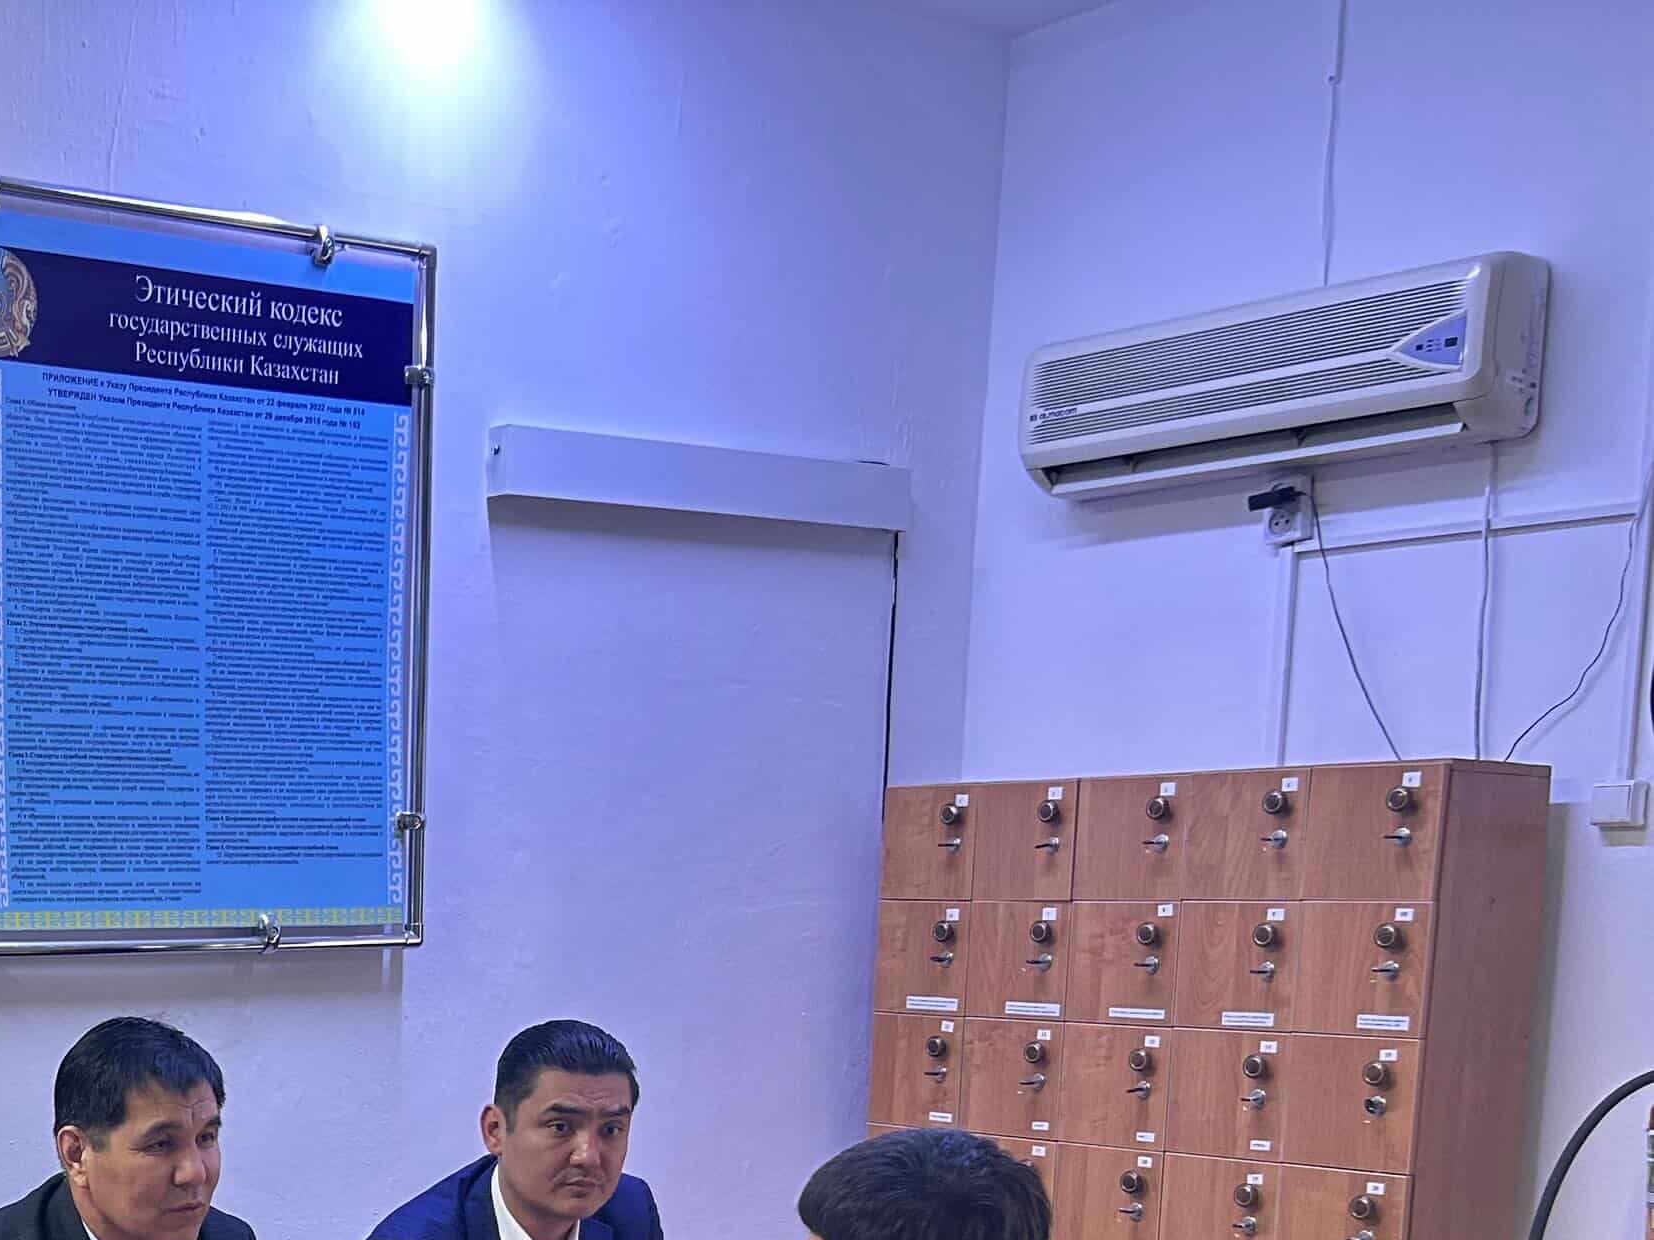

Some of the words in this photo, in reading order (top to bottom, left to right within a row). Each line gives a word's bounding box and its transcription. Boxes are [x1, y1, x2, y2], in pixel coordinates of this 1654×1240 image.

[134, 274, 263, 318] Этический
[269, 300, 344, 329] кодекс
[108, 311, 268, 348] государственных
[272, 331, 364, 359] служащих
[41, 371, 99, 388] ПРИЛОЖЕНИЕ
[134, 340, 245, 374] Республики
[249, 354, 341, 385] Казахстан
[47, 388, 97, 402] УТВЕРЖДЕН
